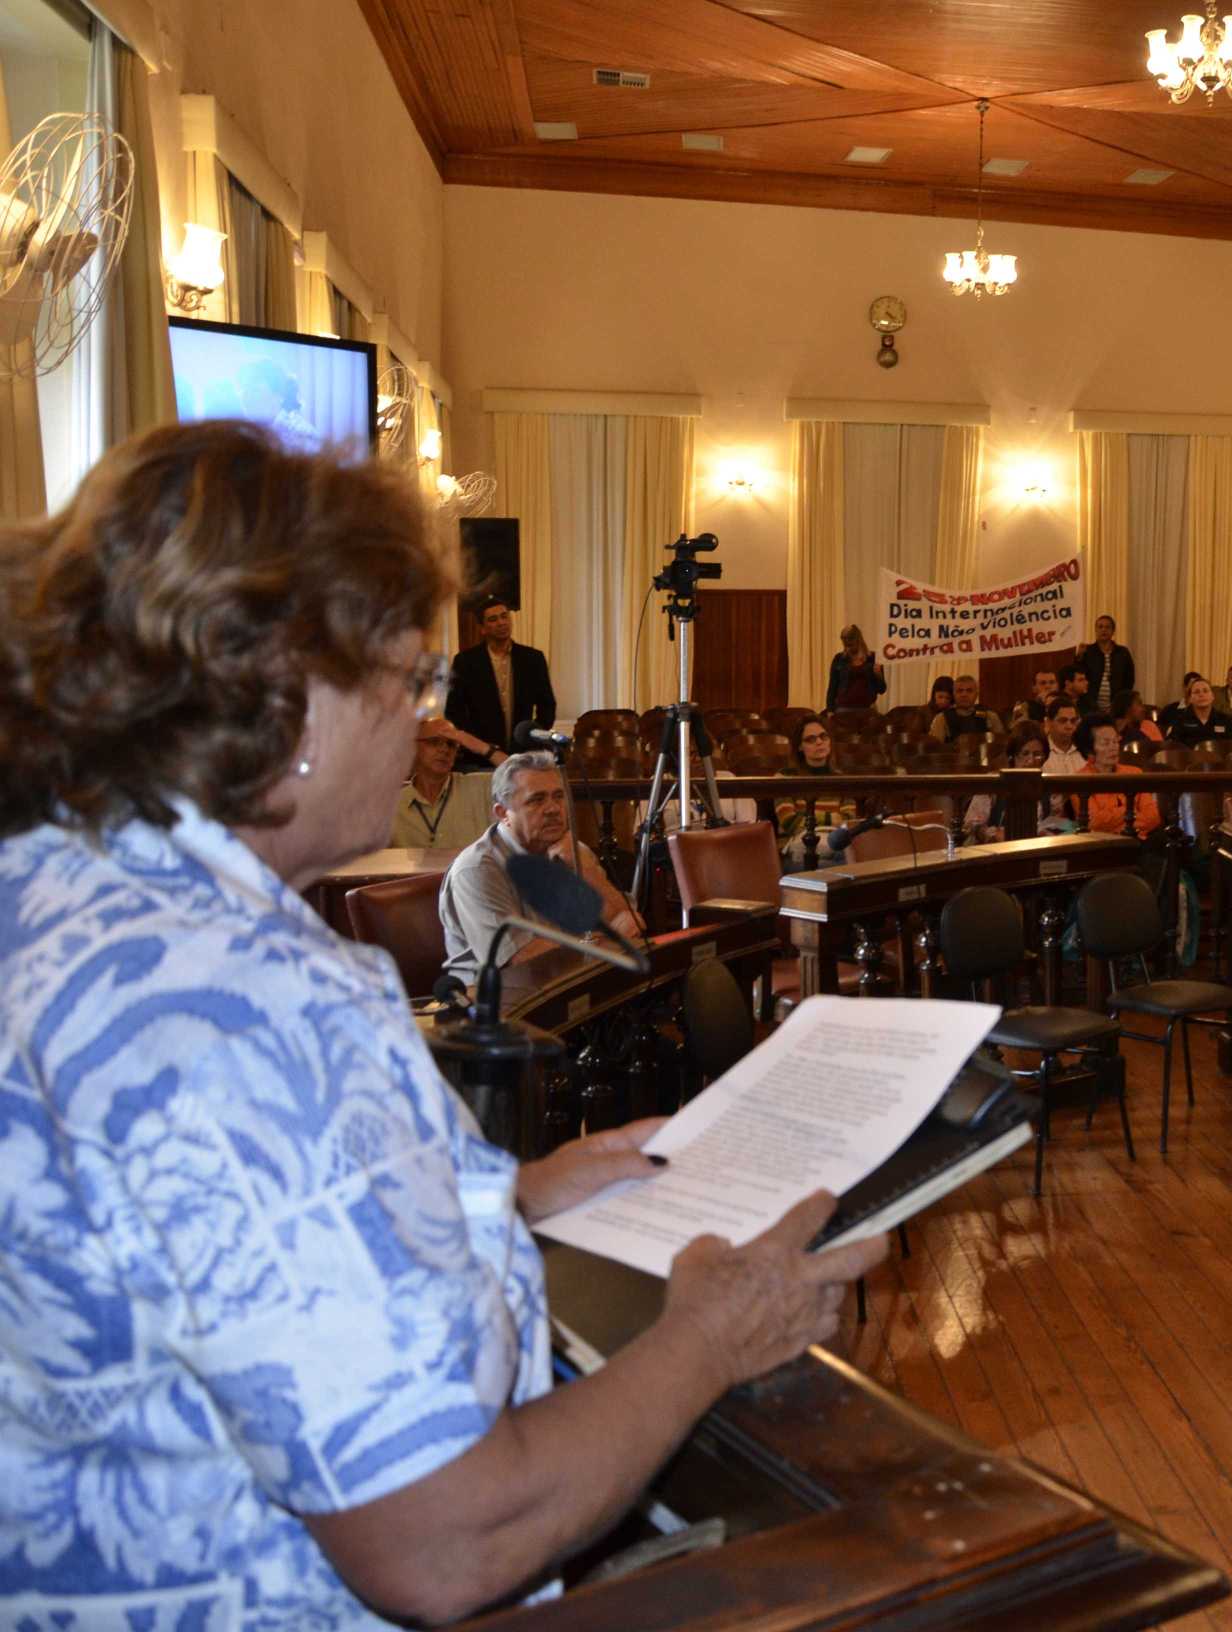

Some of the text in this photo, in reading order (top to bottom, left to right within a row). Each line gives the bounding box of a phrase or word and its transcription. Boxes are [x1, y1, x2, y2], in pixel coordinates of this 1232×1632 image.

[896, 579, 948, 604] 25
[969, 558, 1080, 606] NOVEMBRO
[889, 585, 1064, 619] Dia Internacional
[888, 623, 931, 638] Pela
[938, 624, 976, 638] Não
[883, 640, 954, 660] Contra
[958, 640, 973, 653] a
